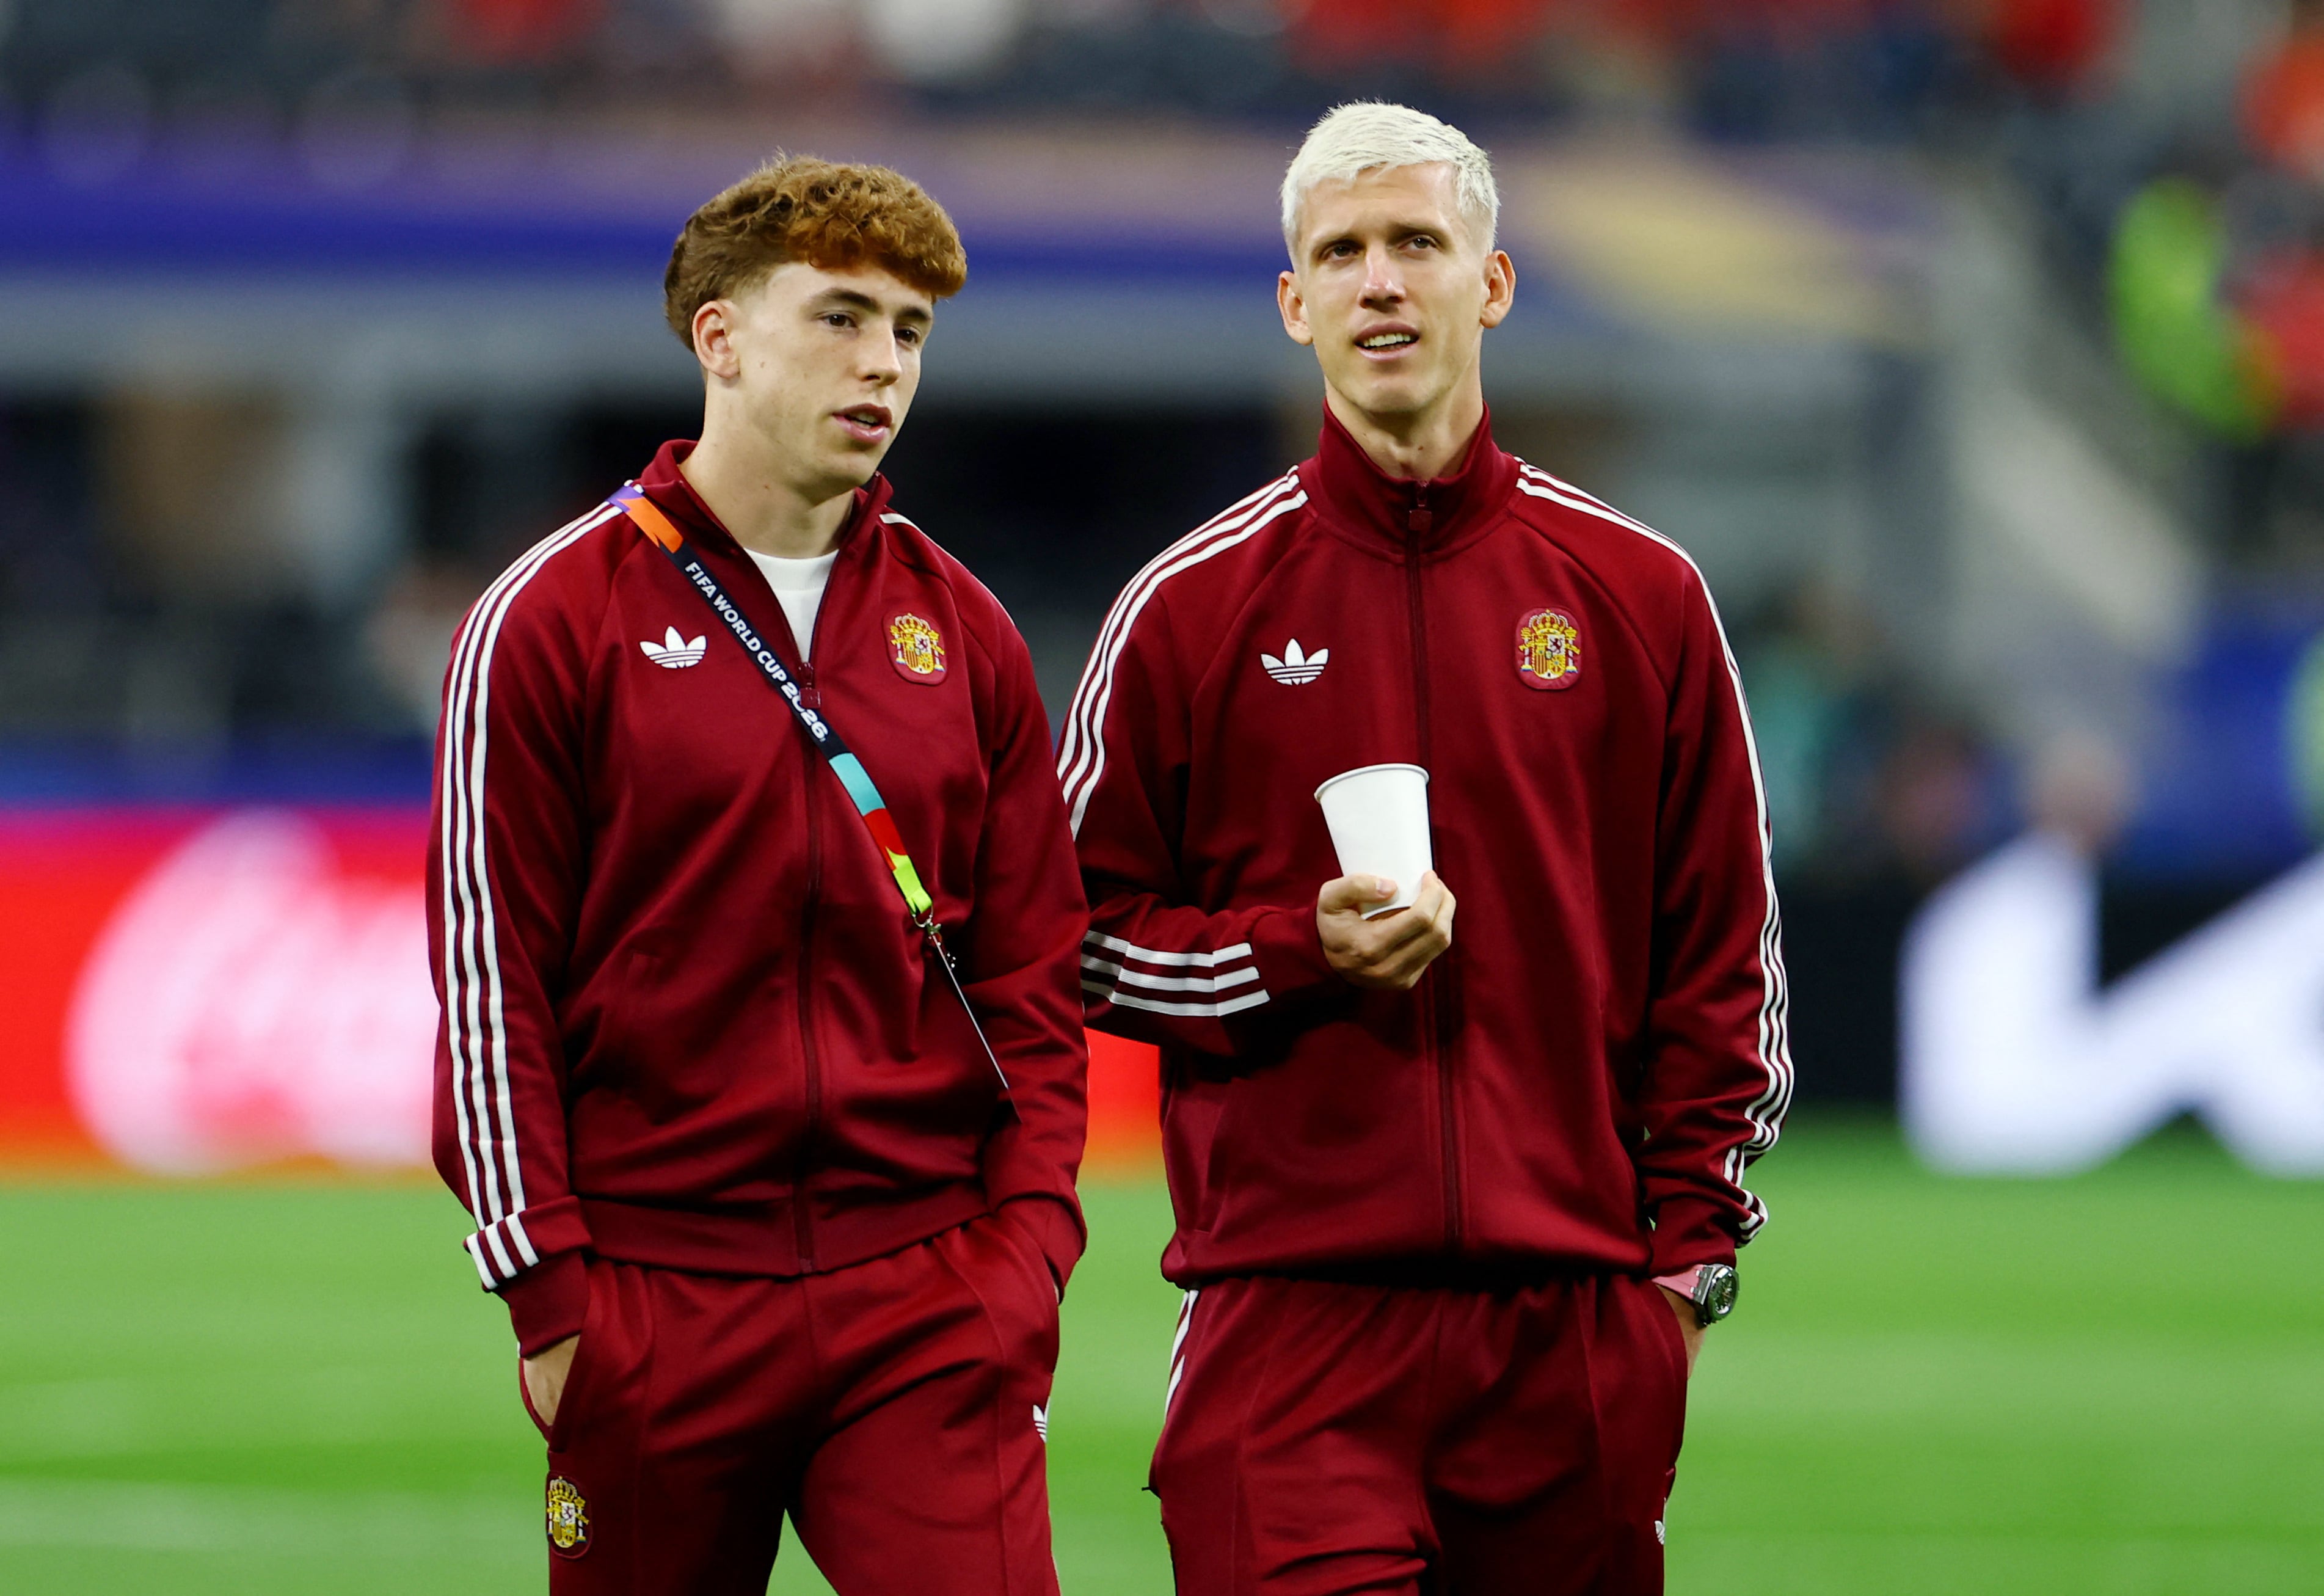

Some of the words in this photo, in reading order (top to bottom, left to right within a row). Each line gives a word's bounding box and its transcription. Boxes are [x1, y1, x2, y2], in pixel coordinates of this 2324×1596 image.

[685, 561, 717, 599] FIFA
[713, 594, 761, 652] WORLD
[757, 650, 787, 682] CUP
